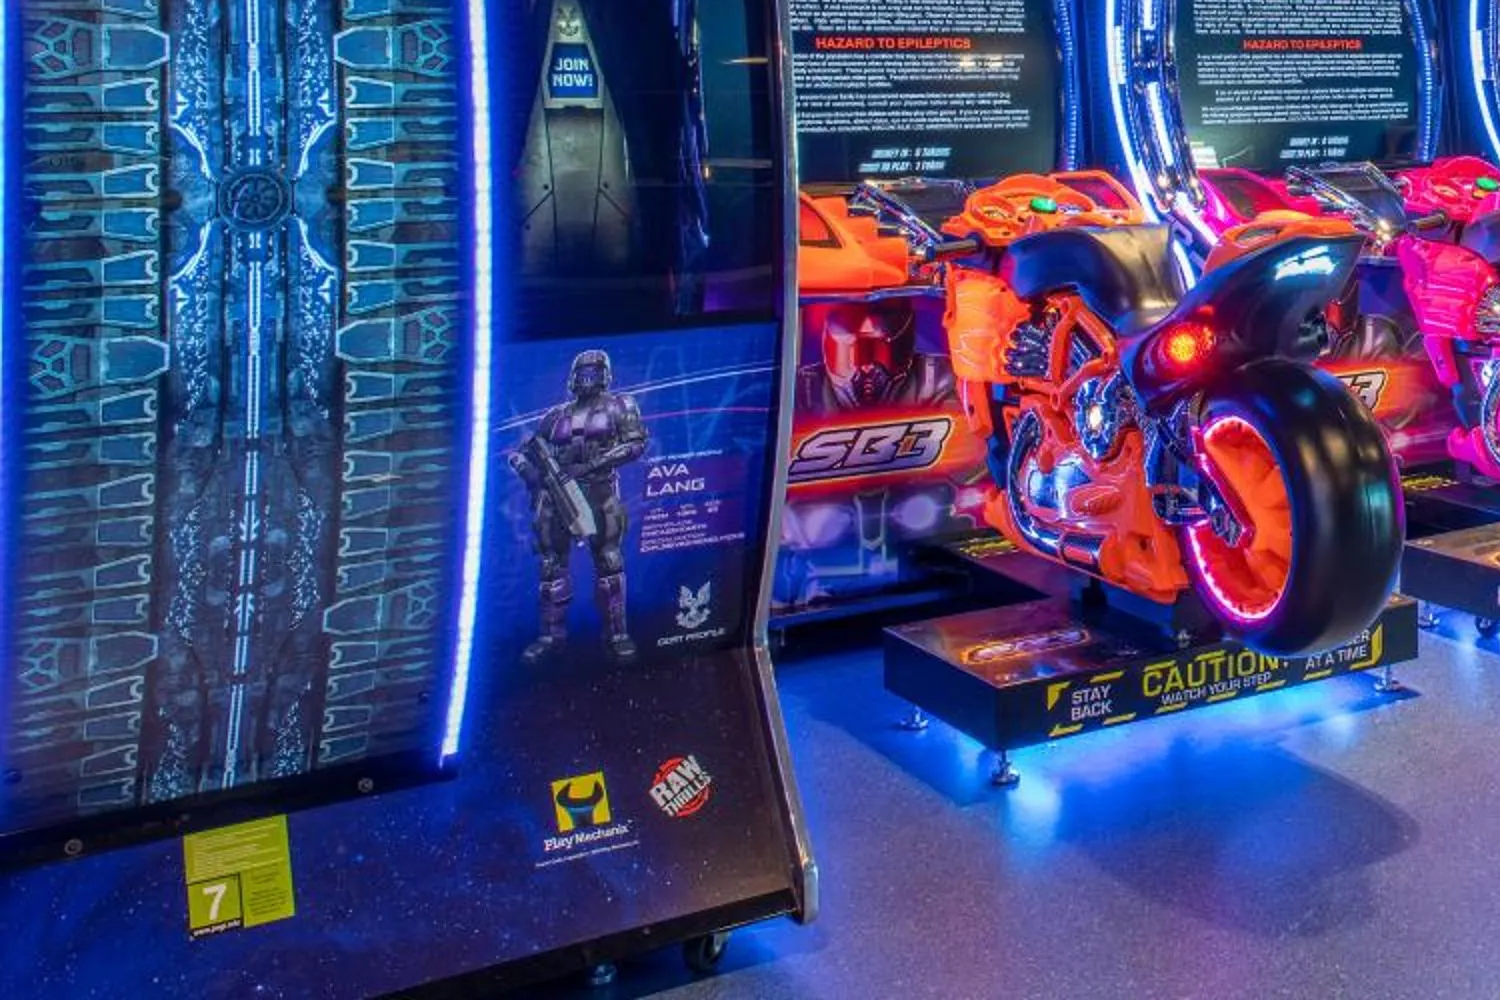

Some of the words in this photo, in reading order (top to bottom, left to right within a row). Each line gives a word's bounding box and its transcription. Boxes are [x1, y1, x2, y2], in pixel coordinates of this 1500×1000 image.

[815, 37, 876, 50] HAZARD
[877, 37, 895, 49] TO
[897, 37, 973, 50] EPILEPTICS
[554, 57, 589, 71] JOIN
[552, 73, 593, 87] NOW!
[788, 419, 951, 477] SB3
[647, 463, 690, 479] AVA
[646, 477, 706, 497] LANG
[1305, 654, 1322, 671] AT
[1325, 653, 1335, 666] A
[1337, 644, 1368, 662] TIME
[1142, 649, 1289, 697] CAUTION
[1071, 684, 1112, 704] STAY
[1161, 688, 1208, 706] WATCH
[1208, 680, 1242, 697] YOUR
[1243, 672, 1272, 690] STEP
[1070, 702, 1113, 721] BACK
[649, 755, 702, 807] RAW
[203, 882, 228, 921] 7
